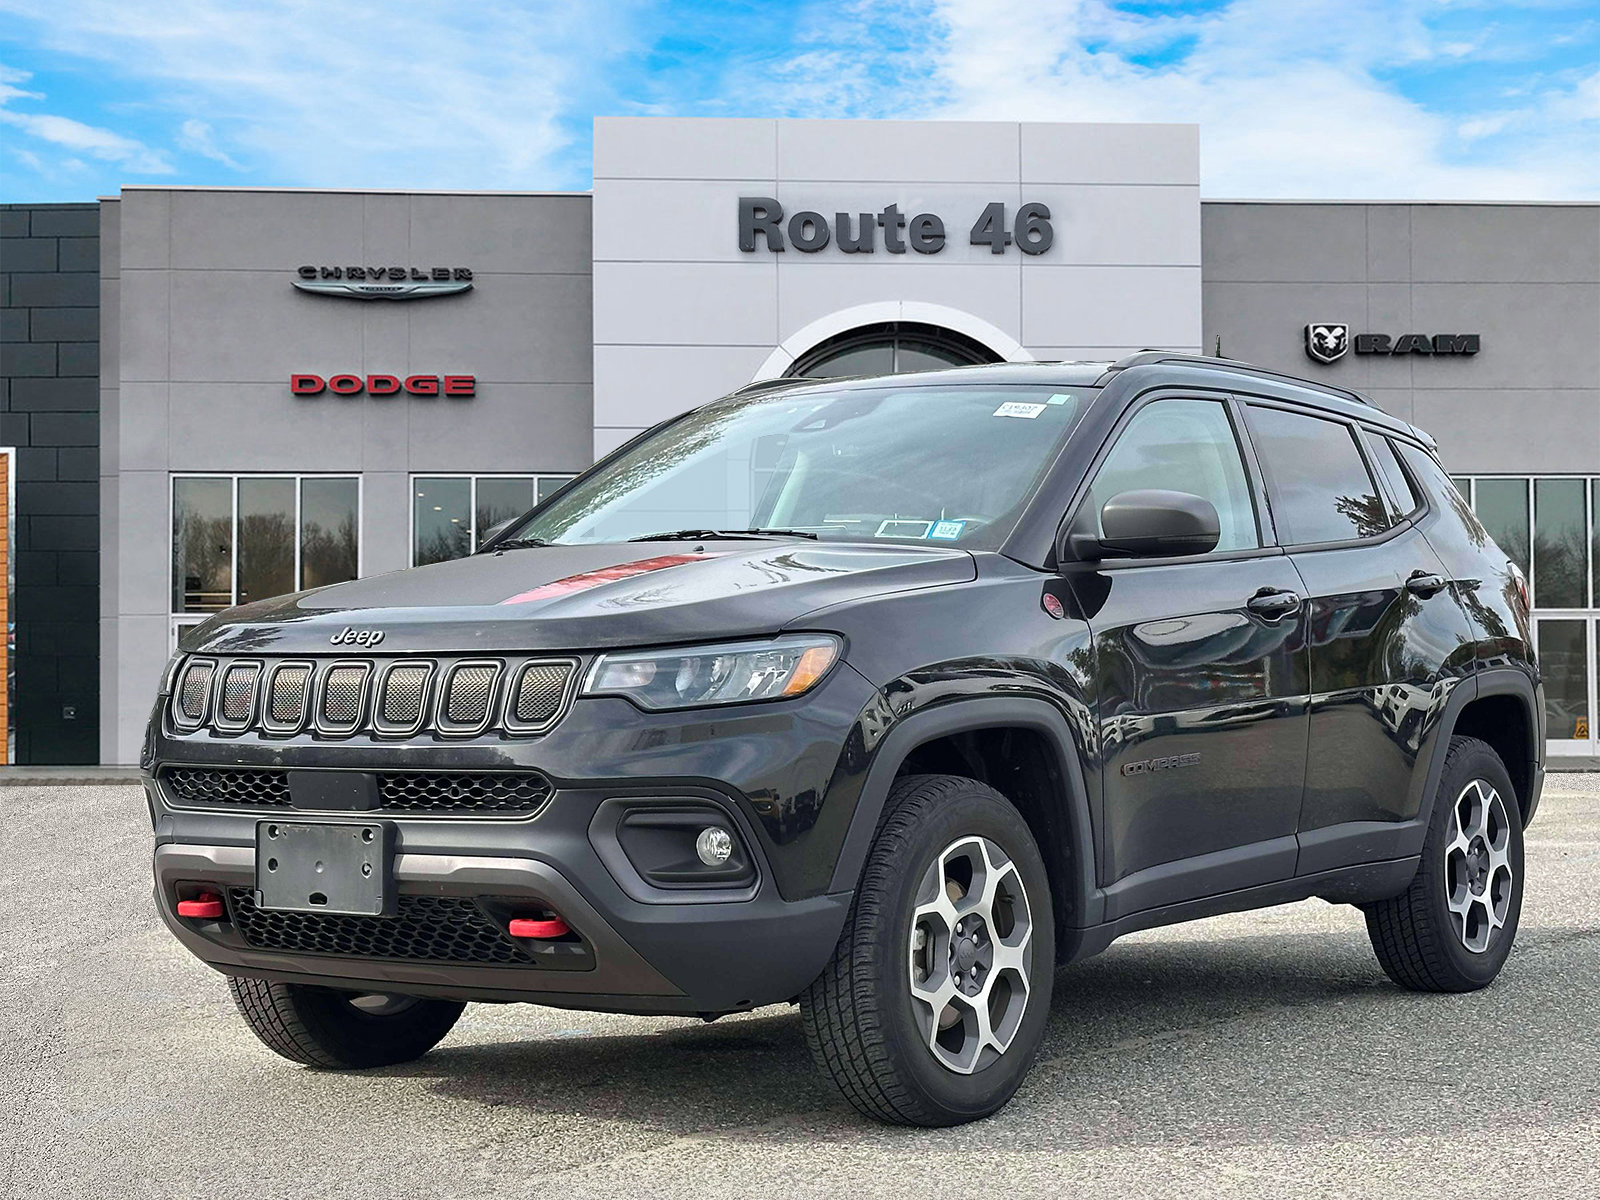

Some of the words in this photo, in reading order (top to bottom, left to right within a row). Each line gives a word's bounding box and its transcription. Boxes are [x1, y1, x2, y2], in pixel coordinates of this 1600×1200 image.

[738, 196, 946, 255] Route
[969, 202, 1054, 255] 46
[298, 265, 473, 280] CHRYSLER
[1354, 333, 1480, 355] RAM
[291, 374, 476, 396] DODGE
[329, 626, 385, 648] Jeep
[1121, 752, 1201, 776] COMPASS
